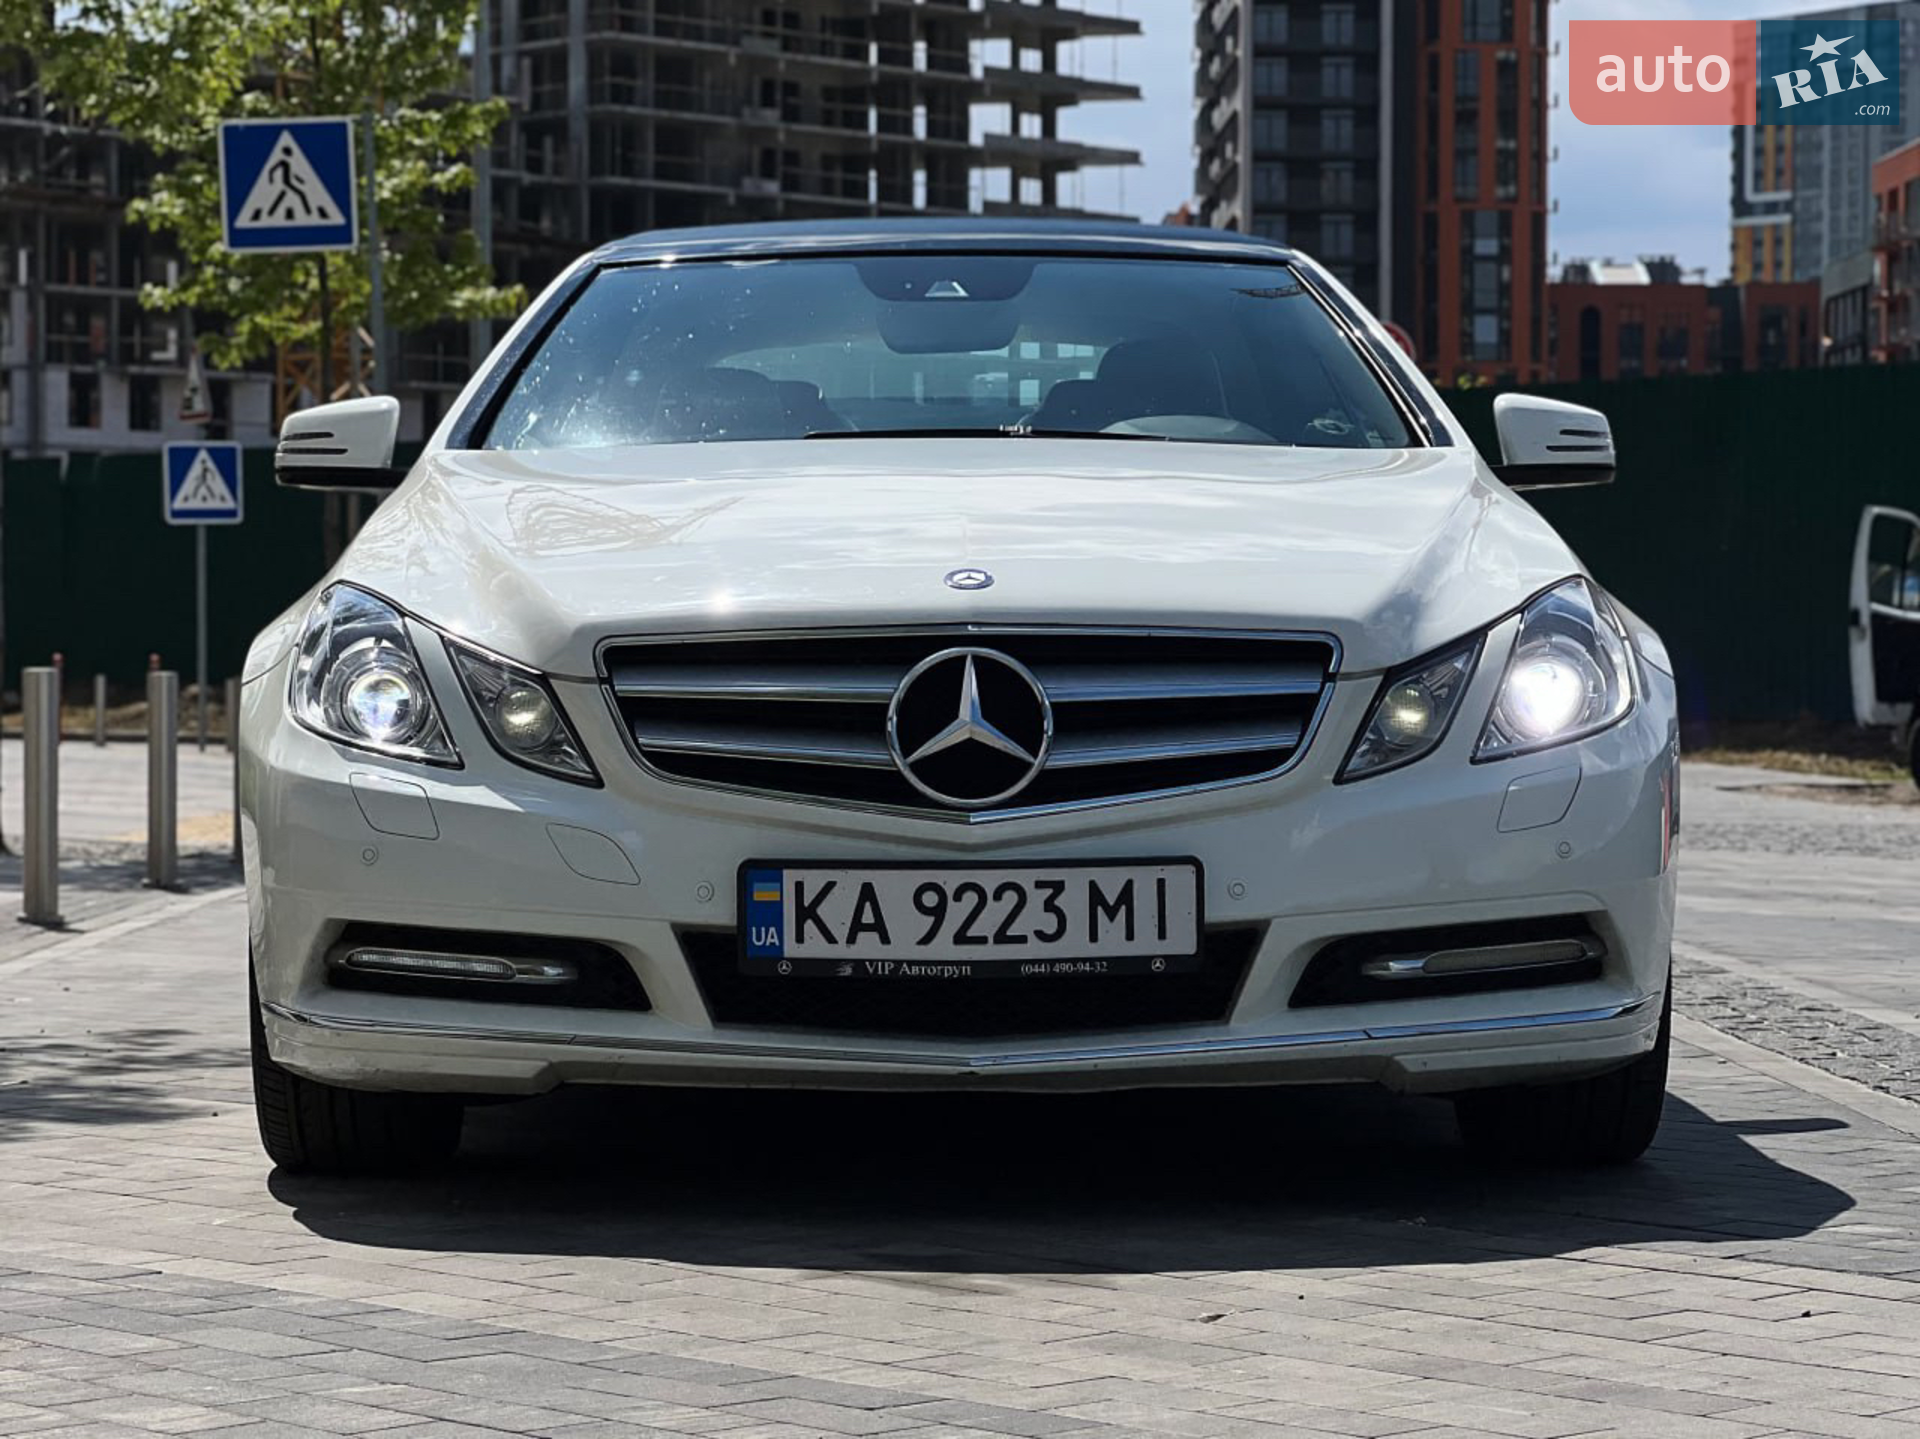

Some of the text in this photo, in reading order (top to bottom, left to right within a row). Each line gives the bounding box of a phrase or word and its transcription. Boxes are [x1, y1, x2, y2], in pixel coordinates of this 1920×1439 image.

[794, 878, 1167, 946] KA 9223 MI
[751, 927, 780, 946] UA
[864, 962, 972, 977] VIP Автогруп
[1020, 963, 1051, 975] (044)
